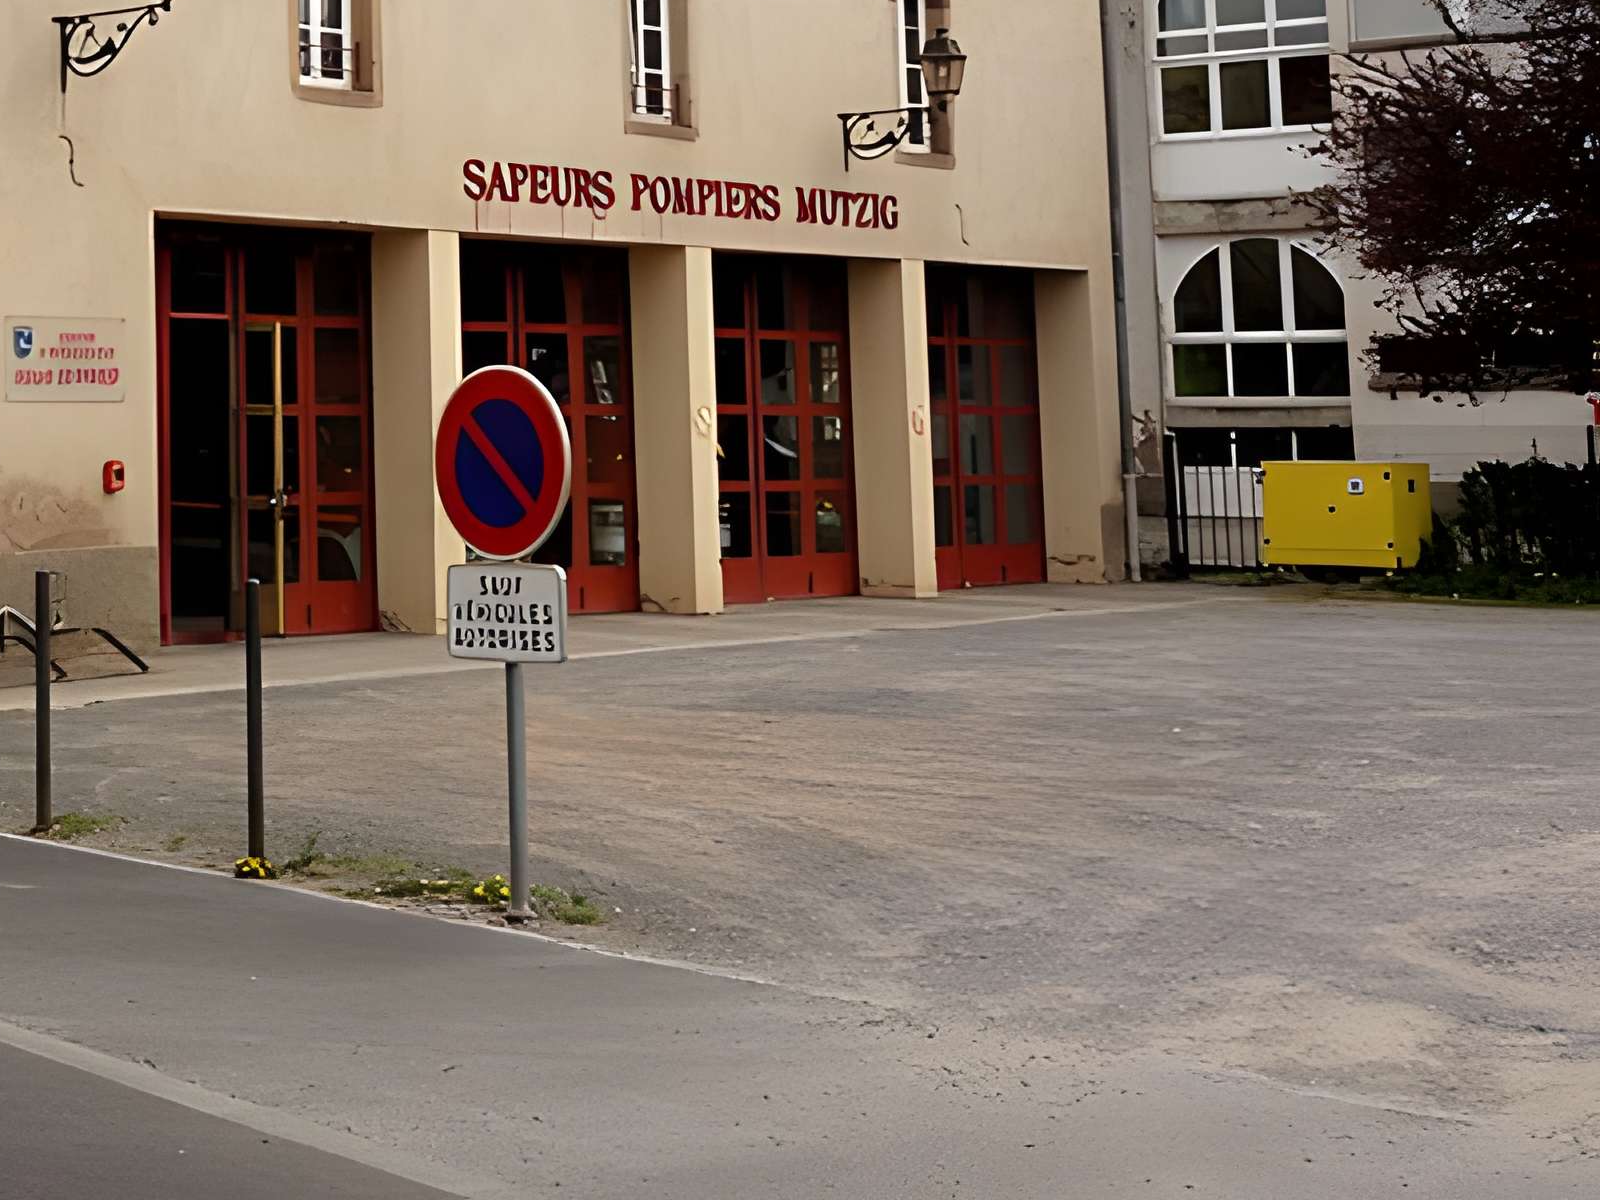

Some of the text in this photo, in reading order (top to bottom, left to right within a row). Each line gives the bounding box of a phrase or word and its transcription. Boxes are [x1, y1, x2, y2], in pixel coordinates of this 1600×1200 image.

[463, 158, 899, 230] SAPEURS POMPIERS MUTZIG
